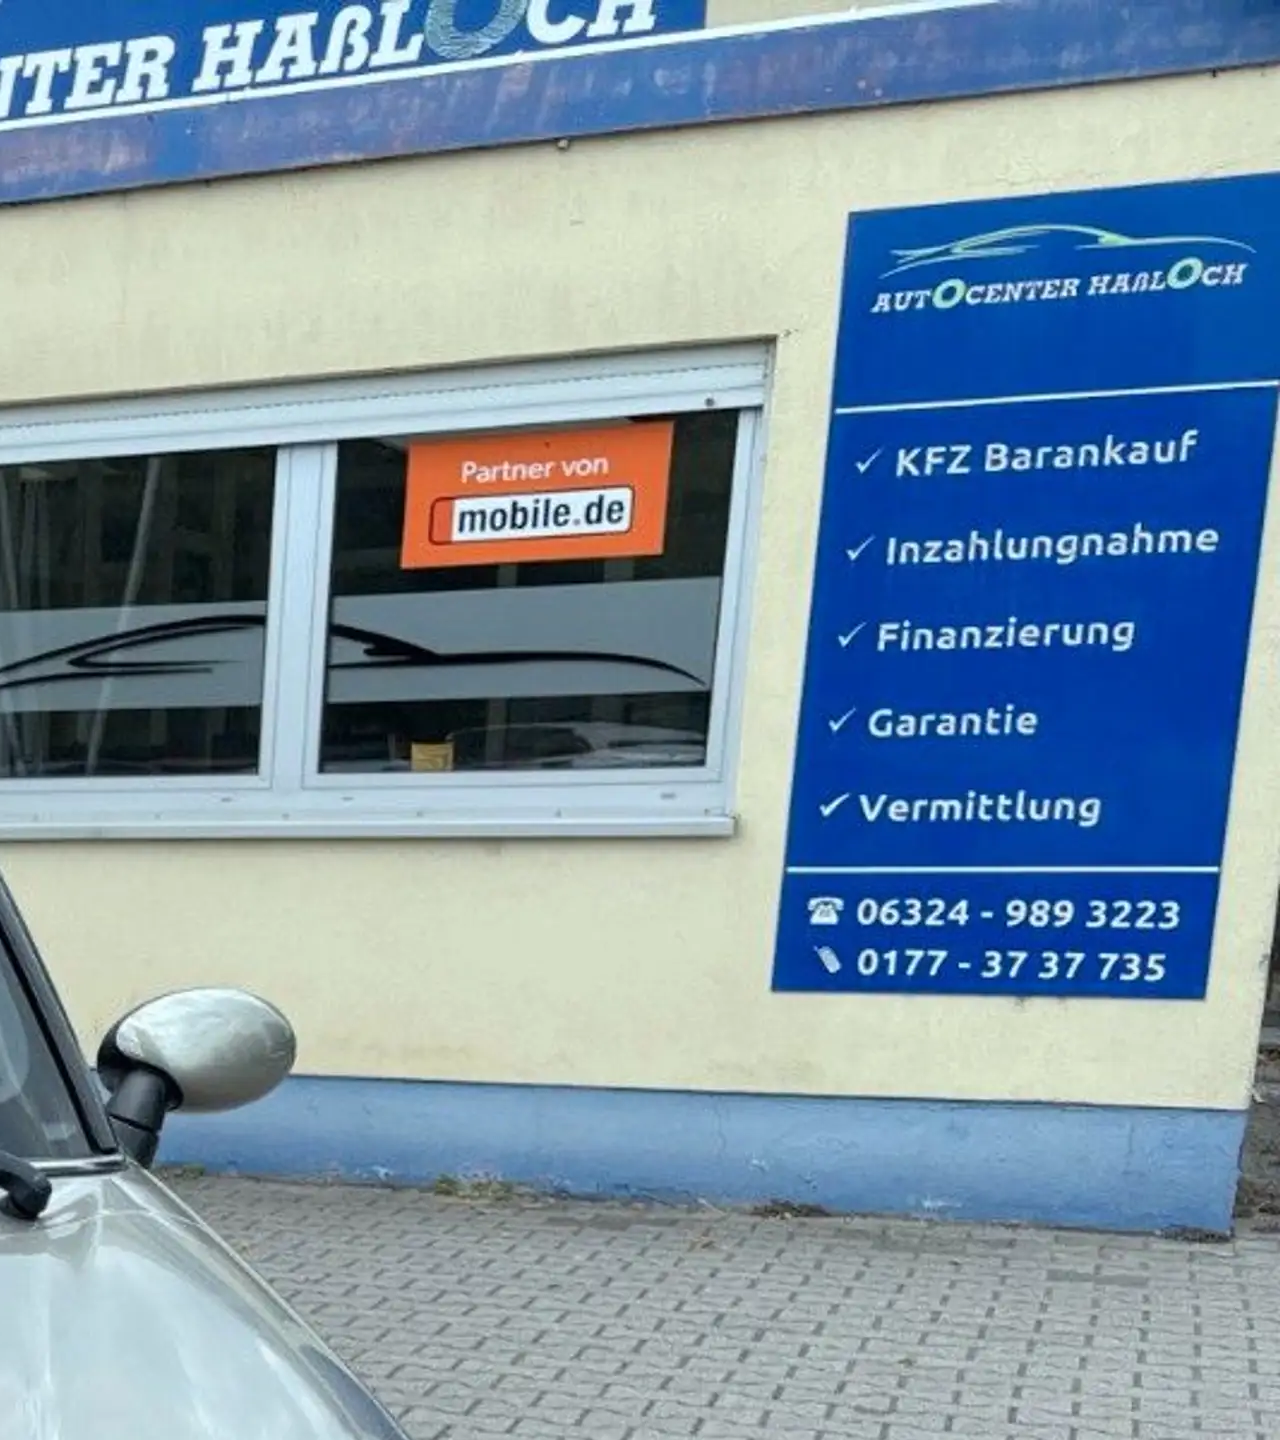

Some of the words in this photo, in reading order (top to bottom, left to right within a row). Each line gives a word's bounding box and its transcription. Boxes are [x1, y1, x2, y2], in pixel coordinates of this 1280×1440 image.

[871, 278, 1081, 313] AUTOCENTER
[1088, 257, 1248, 296] HAßLOCH
[461, 460, 554, 484] Partner
[561, 457, 609, 477] von
[896, 445, 971, 476] KFZ
[984, 429, 1199, 472] Barankauf
[458, 494, 625, 533] mobile.de
[886, 522, 1219, 566] Inzahlungnahme
[877, 616, 1136, 652] Finanzierung
[868, 704, 1038, 738] Garantie
[859, 790, 1102, 827] Vermittlung
[856, 898, 969, 927] 06324
[1005, 899, 1075, 928] 989
[1086, 900, 1180, 930] 3223
[857, 948, 947, 977] 0177
[980, 951, 1028, 979] 37
[1038, 952, 1086, 980] 37
[1098, 952, 1166, 982] 735
